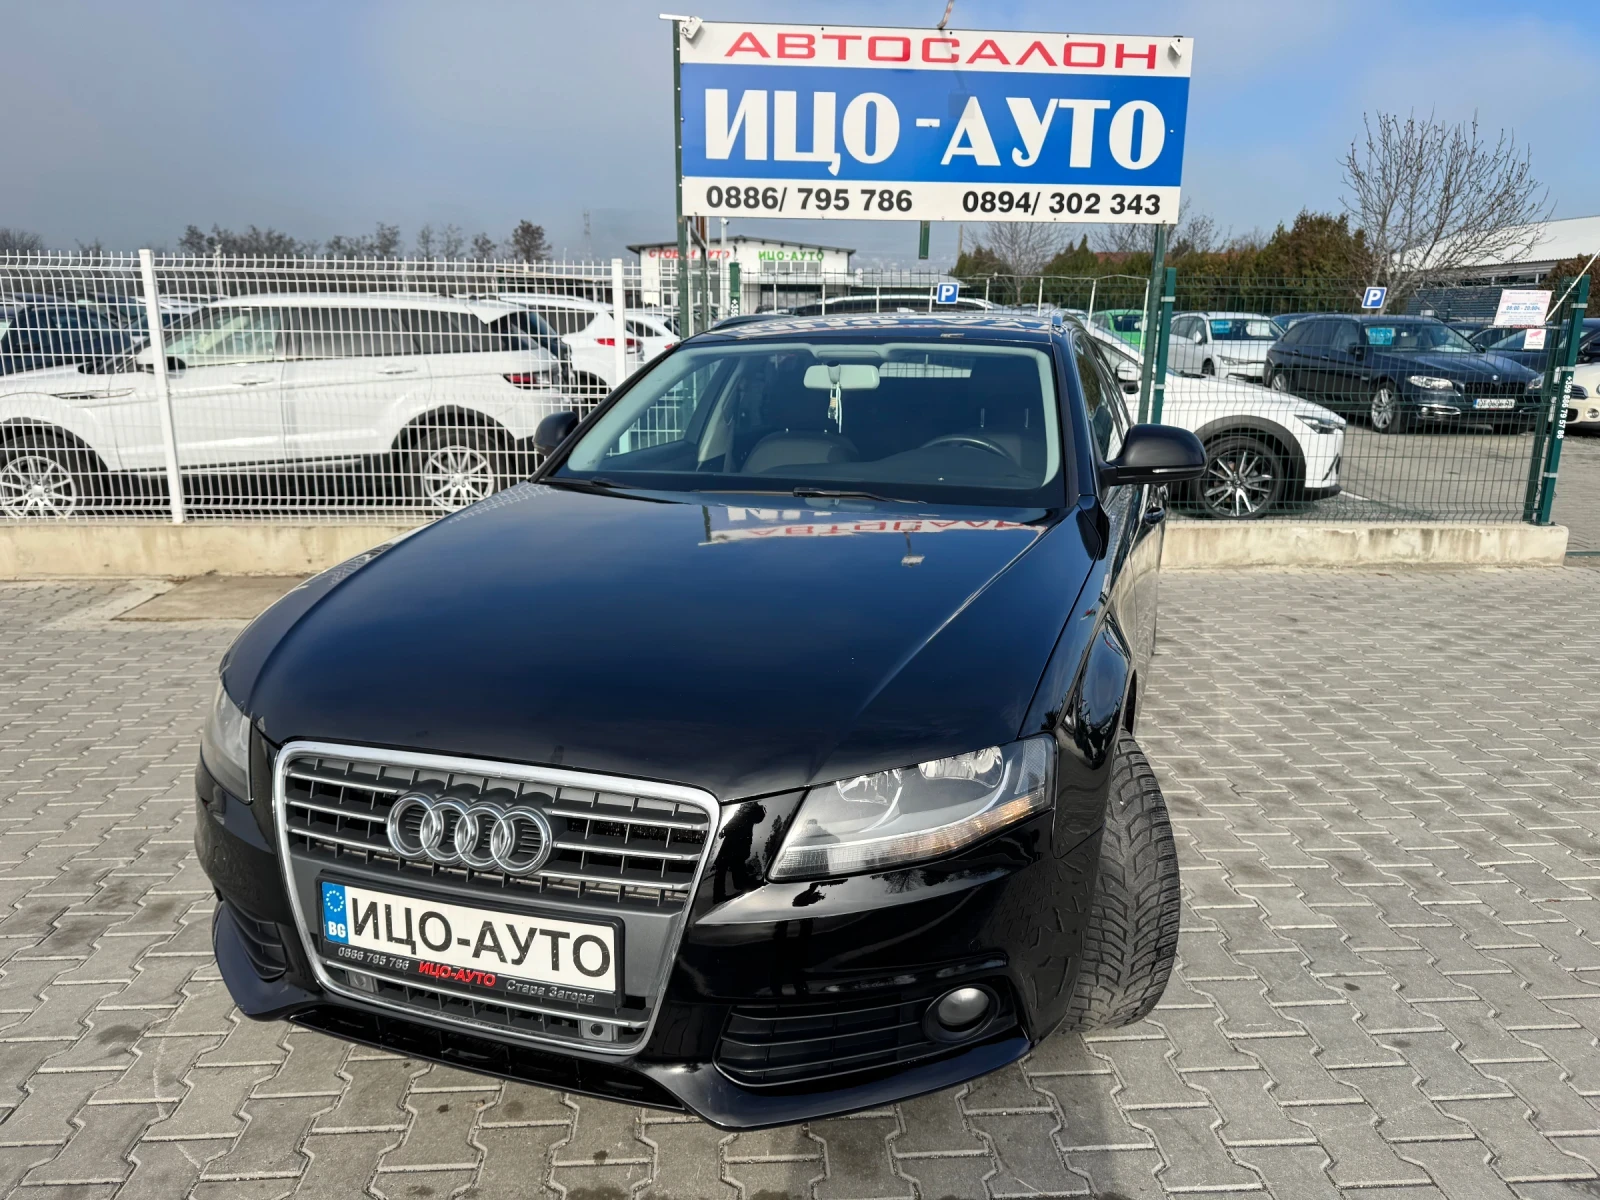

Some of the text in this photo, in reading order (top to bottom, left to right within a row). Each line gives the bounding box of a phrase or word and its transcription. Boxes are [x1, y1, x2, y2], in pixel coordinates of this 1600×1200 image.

[724, 31, 1157, 69] АВТОСАЛОН
[706, 185, 913, 212] 0886/ 795 786
[962, 191, 1161, 216] 0894/ 302 343
[758, 250, 825, 262] ИЦО-АУТО
[942, 285, 954, 301] P
[1366, 290, 1382, 306] P
[1556, 376, 1573, 439] +359 886 79 57 86
[328, 921, 346, 938] BG
[351, 897, 611, 977] ИЦО-АУТО
[337, 947, 595, 1004] 0886 795 786 ИЦО-АУТО Стара Загора
